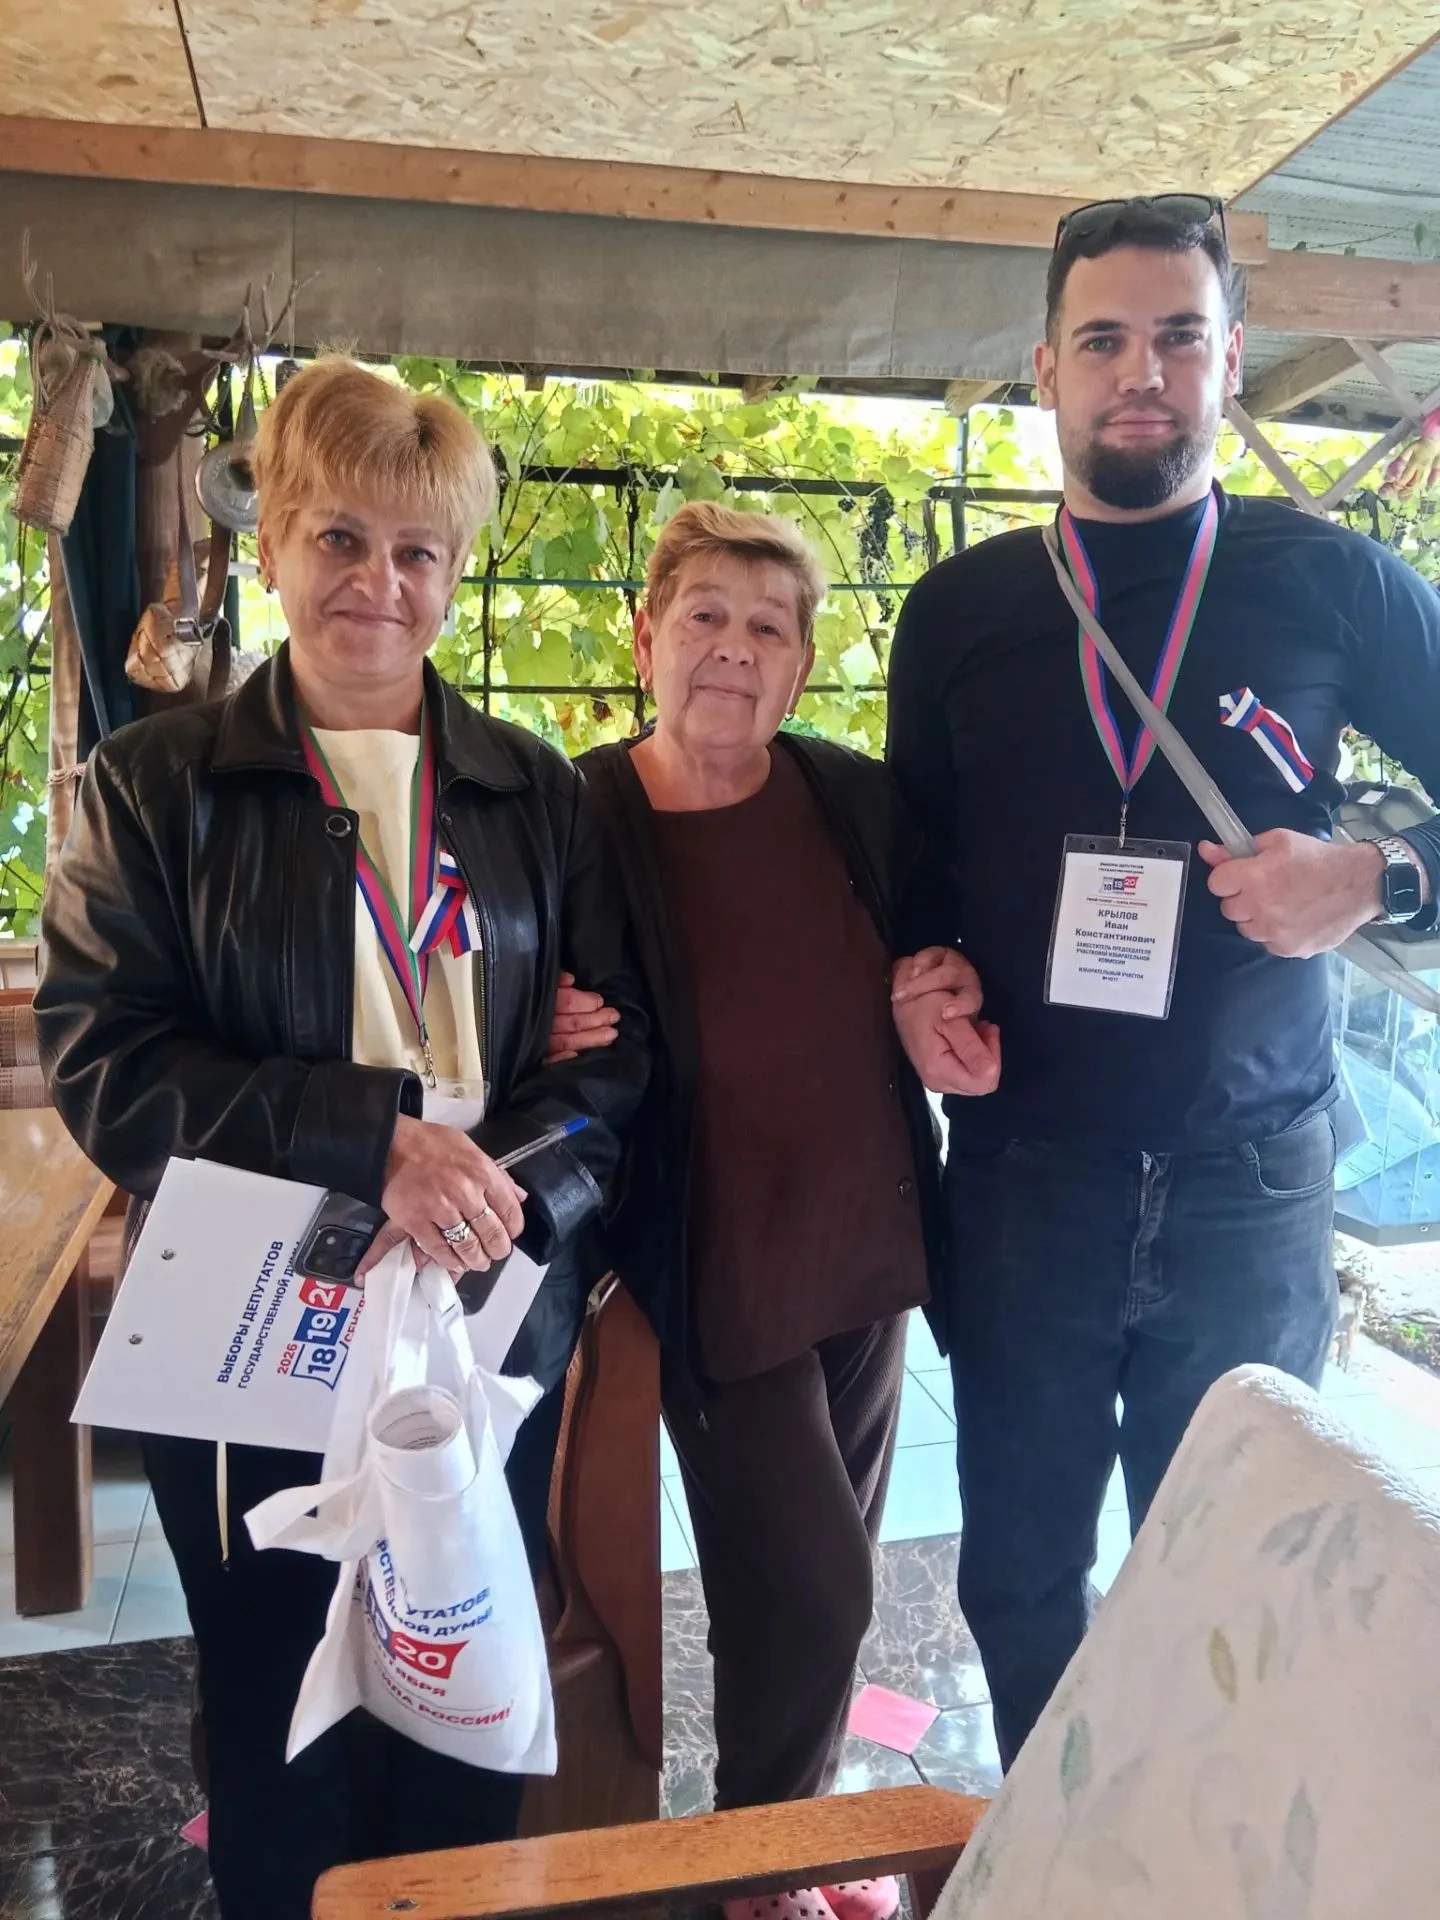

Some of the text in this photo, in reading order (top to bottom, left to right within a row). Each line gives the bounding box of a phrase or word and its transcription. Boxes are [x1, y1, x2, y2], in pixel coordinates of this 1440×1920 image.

[1104, 883, 1112, 891] 18
[1098, 909, 1138, 920] КРЫЛОВ
[1104, 920, 1128, 930] Иван
[1076, 928, 1156, 944] Константинович
[217, 1240, 284, 1384] ВЫБОРЫ ДЕПУТАТОВ
[238, 1279, 290, 1389] ГОСУДАРСТВЕННОЙ
[306, 1312, 337, 1340] 19
[276, 1343, 298, 1376] 2026
[307, 1348, 337, 1374] 18
[406, 1586, 490, 1620] УТАТОВ
[394, 1637, 448, 1670] 20
[418, 1703, 511, 1726] РОССИИ!
